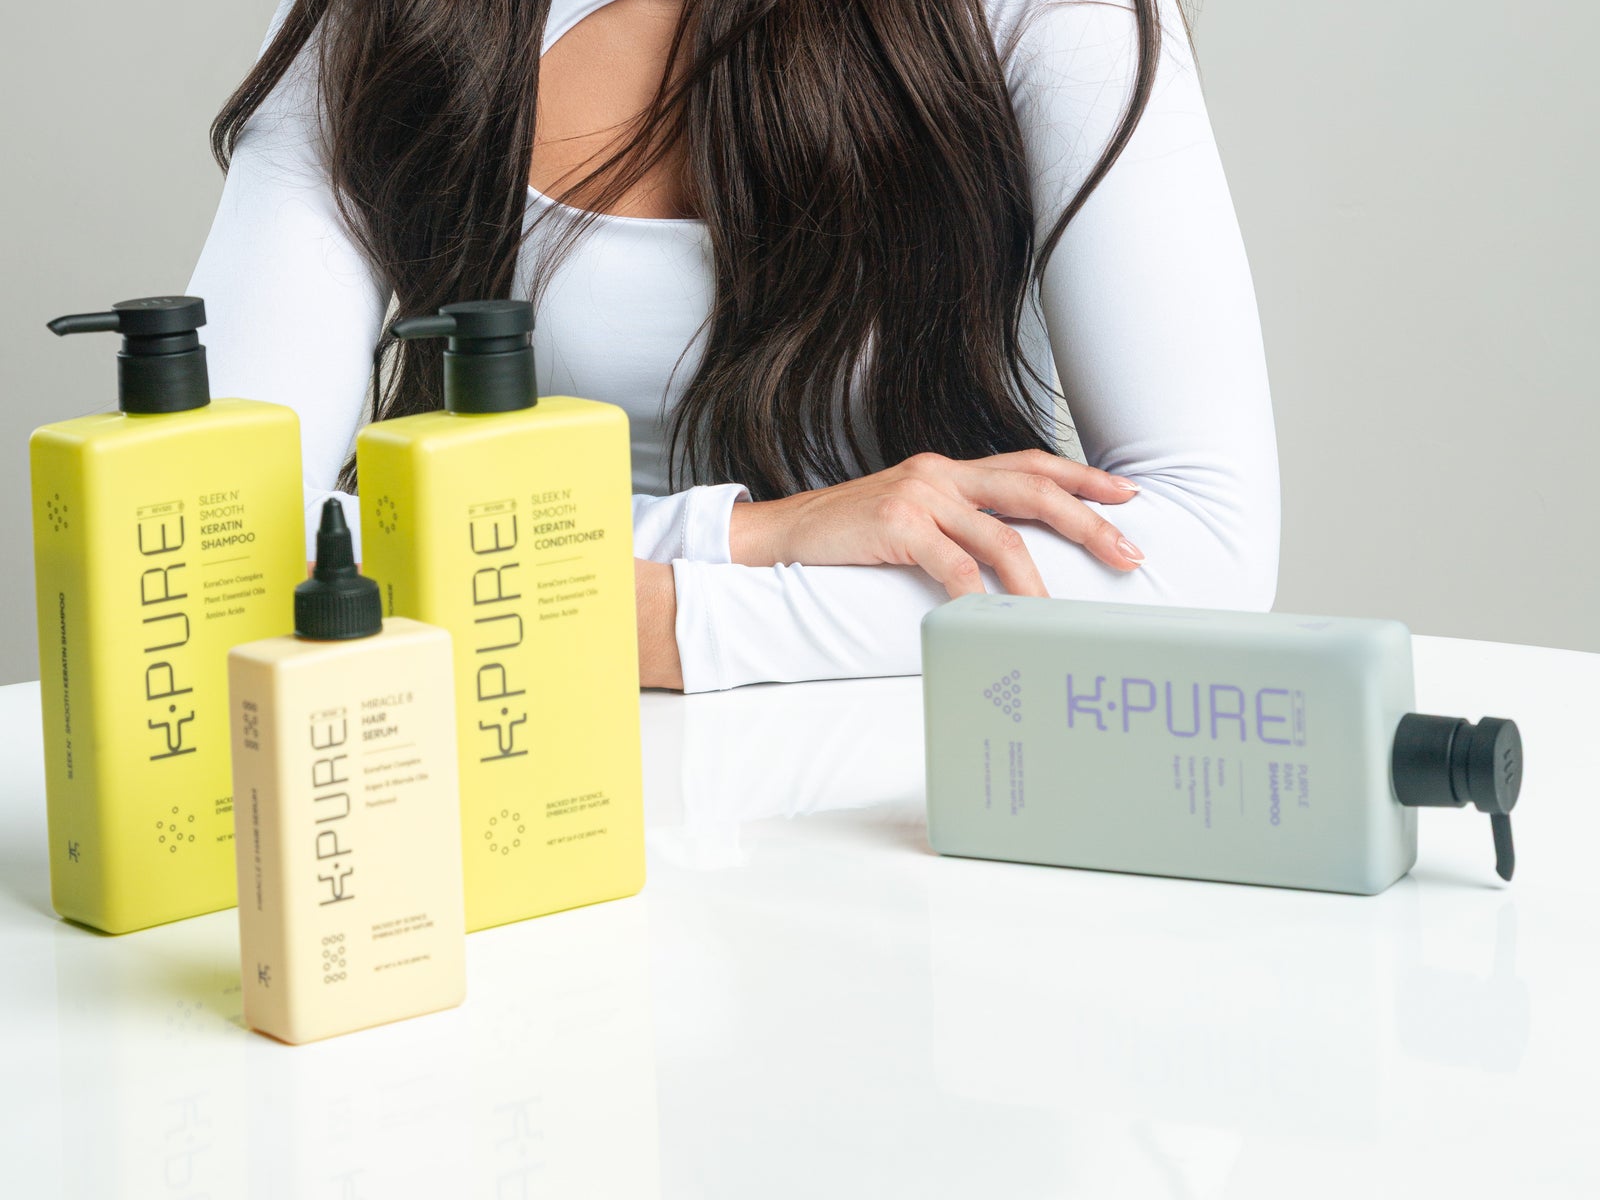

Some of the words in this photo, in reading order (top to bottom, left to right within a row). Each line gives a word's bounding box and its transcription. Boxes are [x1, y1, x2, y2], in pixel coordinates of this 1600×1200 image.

[199, 492, 228, 506] SLEEK
[531, 492, 560, 505] SLEEK
[200, 504, 244, 521] SMOOTH
[532, 503, 577, 521] SMOOTH
[201, 519, 243, 535] KERATIN
[533, 518, 576, 535] KERATIN
[201, 532, 256, 550] SHAMPOO
[534, 529, 605, 551] CONDITIONER
[235, 572, 264, 584] Complex
[204, 596, 221, 606] Plant
[222, 589, 252, 602] Essential
[252, 587, 267, 597] Oils
[59, 592, 67, 646] SHAMPOO
[205, 611, 227, 621] Amino
[227, 606, 246, 618] Acids
[361, 693, 403, 709] MIRACLE
[64, 689, 72, 735] SMOOTH
[362, 712, 387, 726] HAIR
[362, 726, 398, 741] SERUM
[1283, 761, 1294, 792] RAIN
[1268, 761, 1281, 827] SHAMPOO
[1297, 763, 1309, 809] PURPLE
